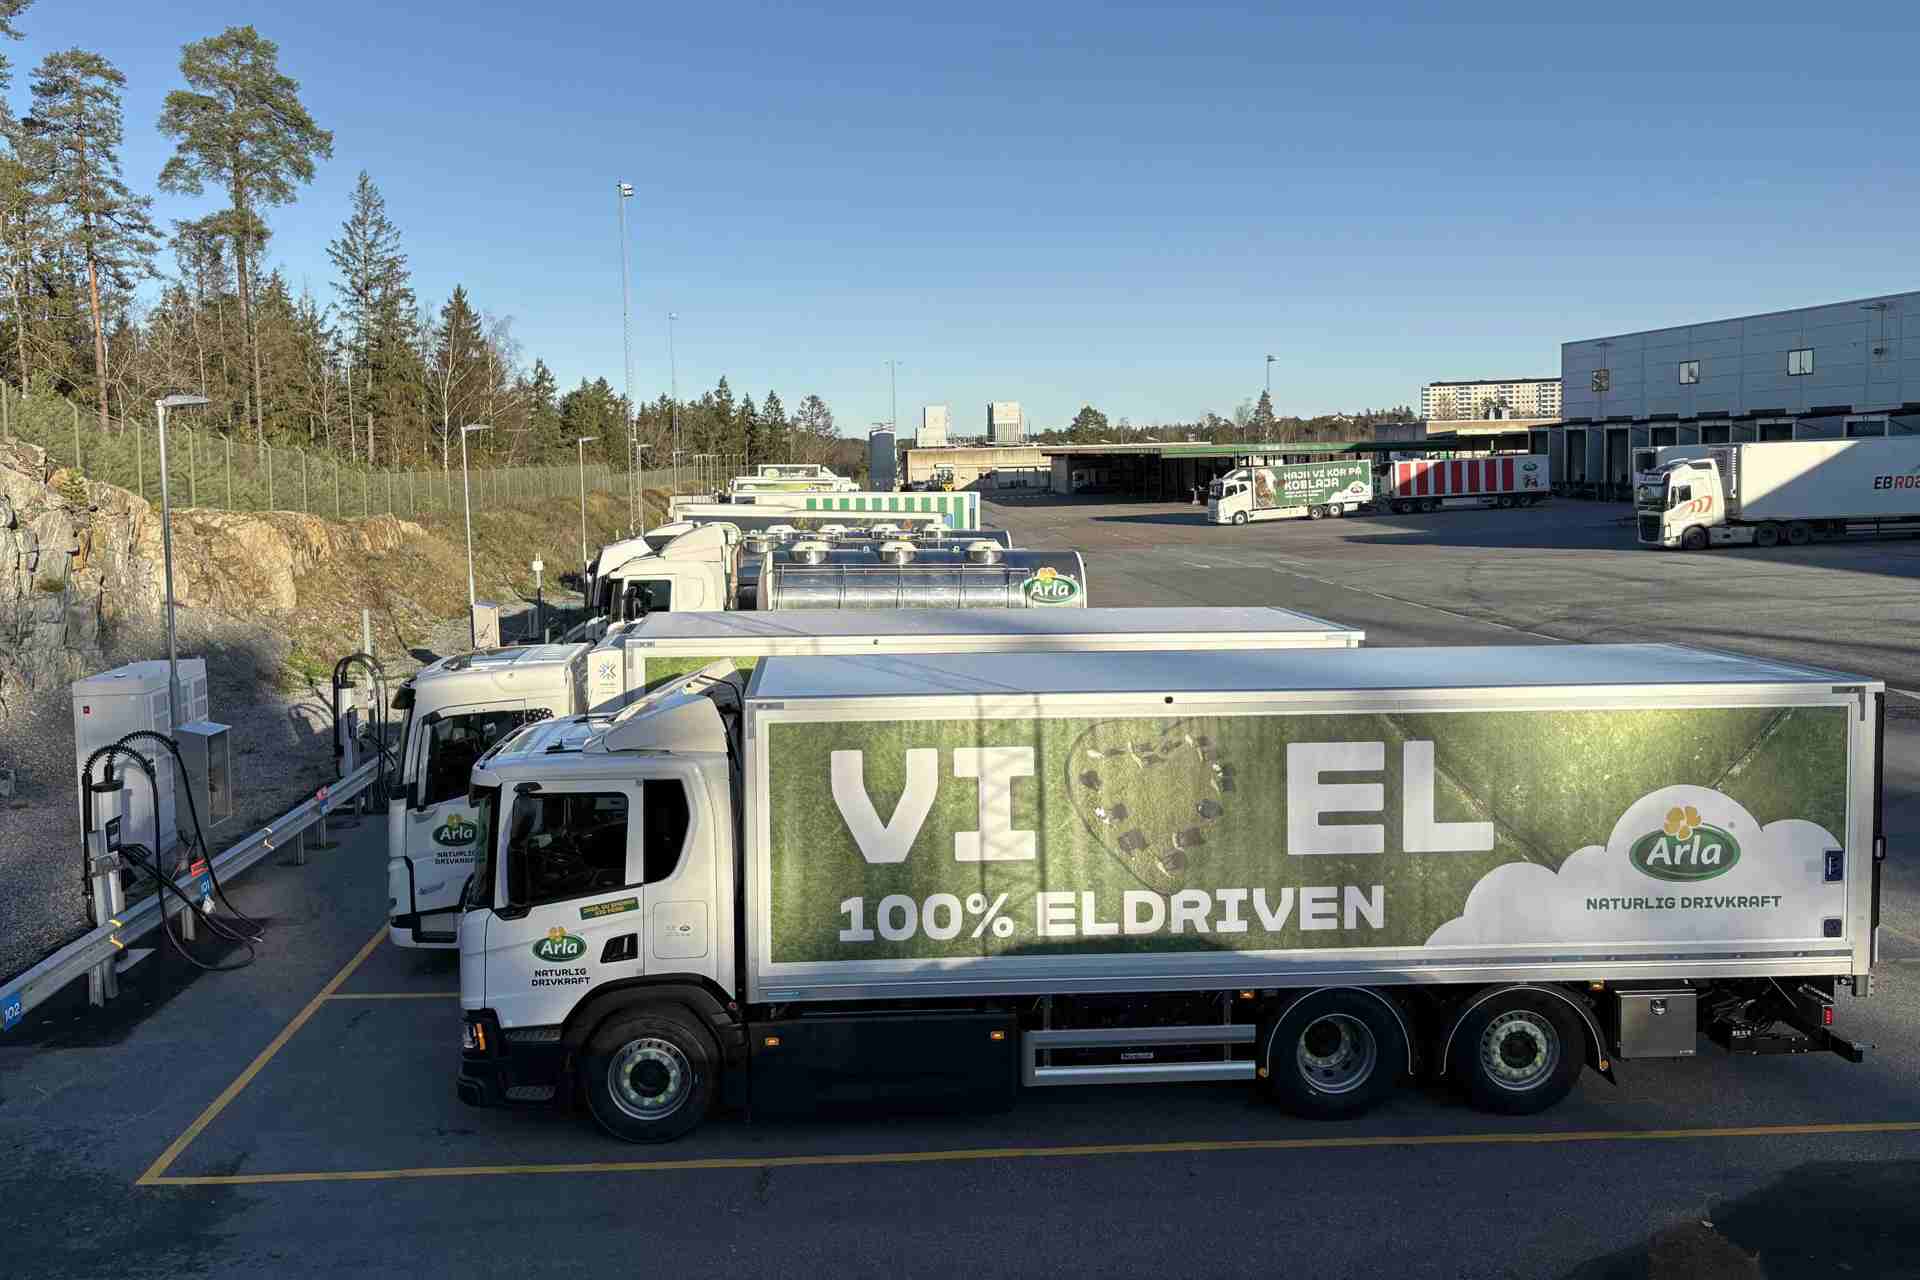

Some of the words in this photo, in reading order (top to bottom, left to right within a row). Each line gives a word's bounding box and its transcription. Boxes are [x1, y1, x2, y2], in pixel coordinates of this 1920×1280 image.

[1030, 580, 1070, 597] Arla
[831, 746, 1036, 864] VI
[1287, 741, 1495, 856] EL
[440, 824, 474, 841] Arla
[1646, 834, 1723, 866] Arla
[1586, 897, 1676, 911] NATURLIG
[1680, 895, 1782, 909] DRIVKRAFT
[839, 892, 1015, 943] 100%
[1036, 885, 1385, 938] ELDRIVEN
[540, 939, 578, 955] Arla
[534, 967, 587, 978] NATURLIG
[531, 976, 591, 987] DRIVKRAFT
